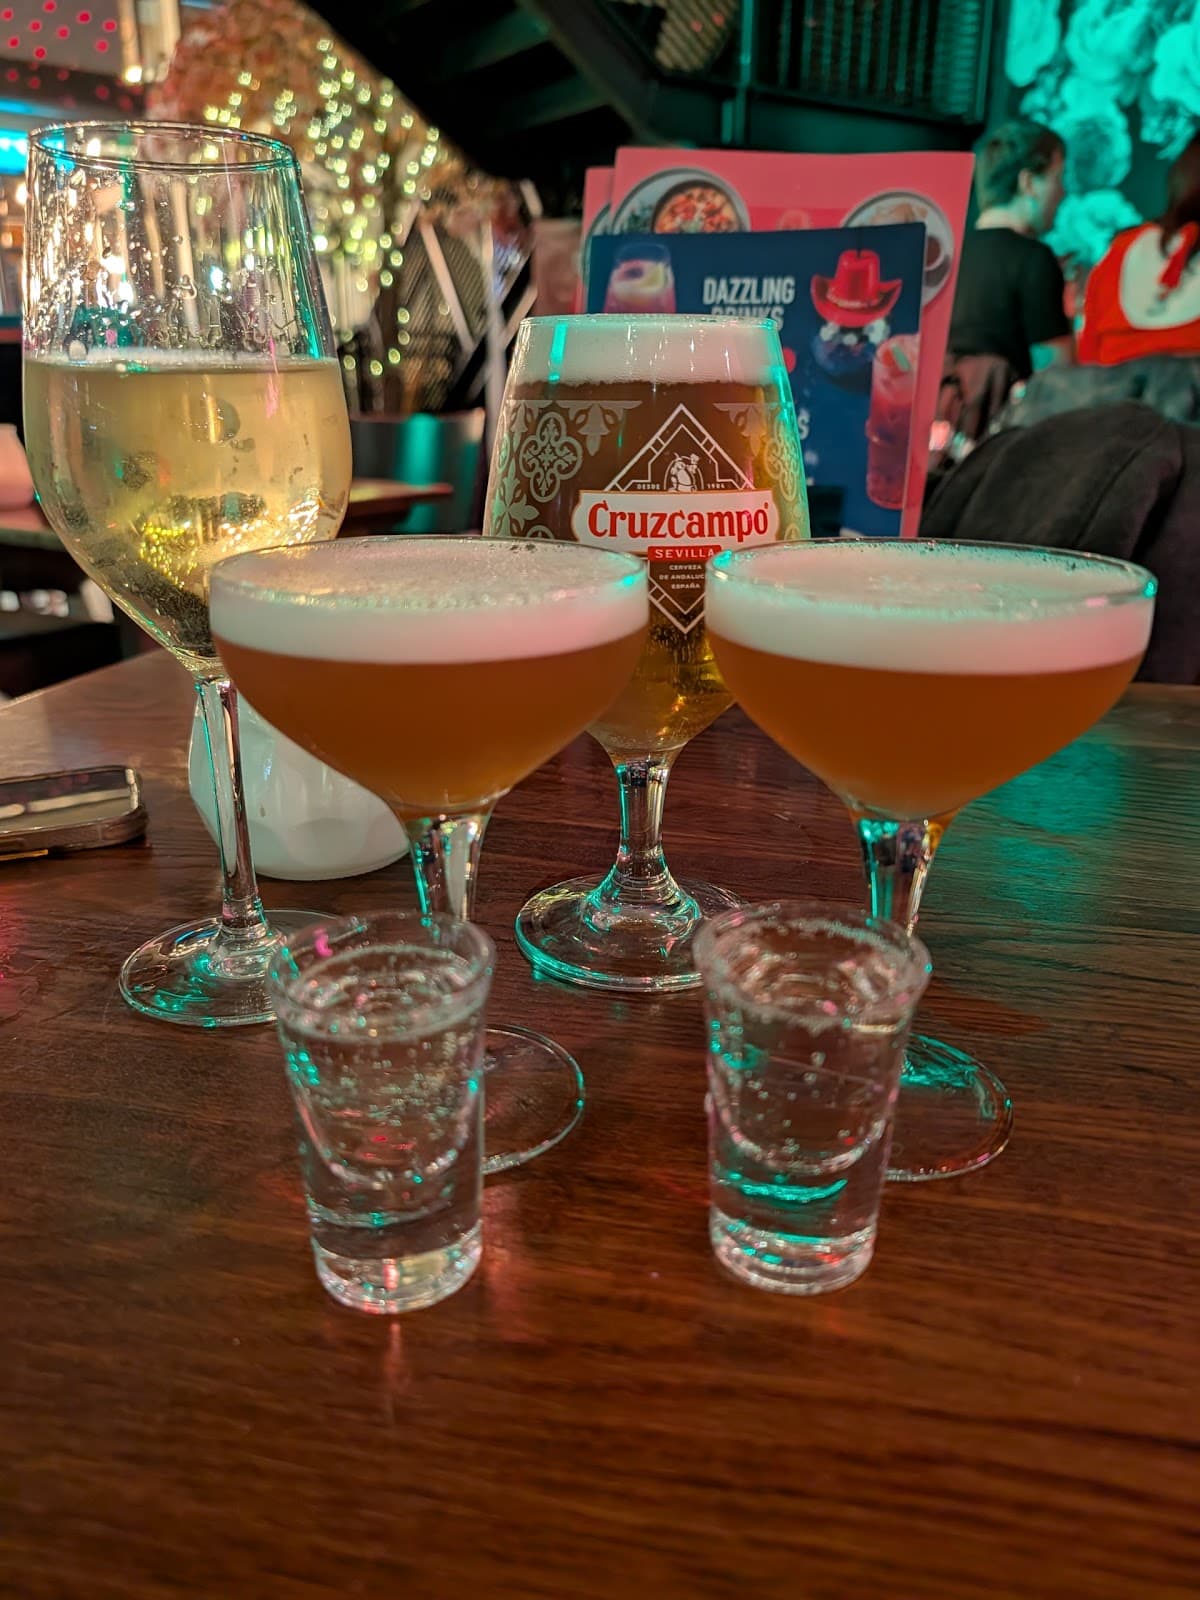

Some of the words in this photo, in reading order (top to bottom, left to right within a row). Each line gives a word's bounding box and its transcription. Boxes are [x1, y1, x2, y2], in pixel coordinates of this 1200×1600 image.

[702, 276, 795, 305] DAZZLING
[588, 500, 768, 542] Cruzcampo
[655, 549, 715, 559] SEVILLA
[671, 582, 700, 590] ESPAÑA
